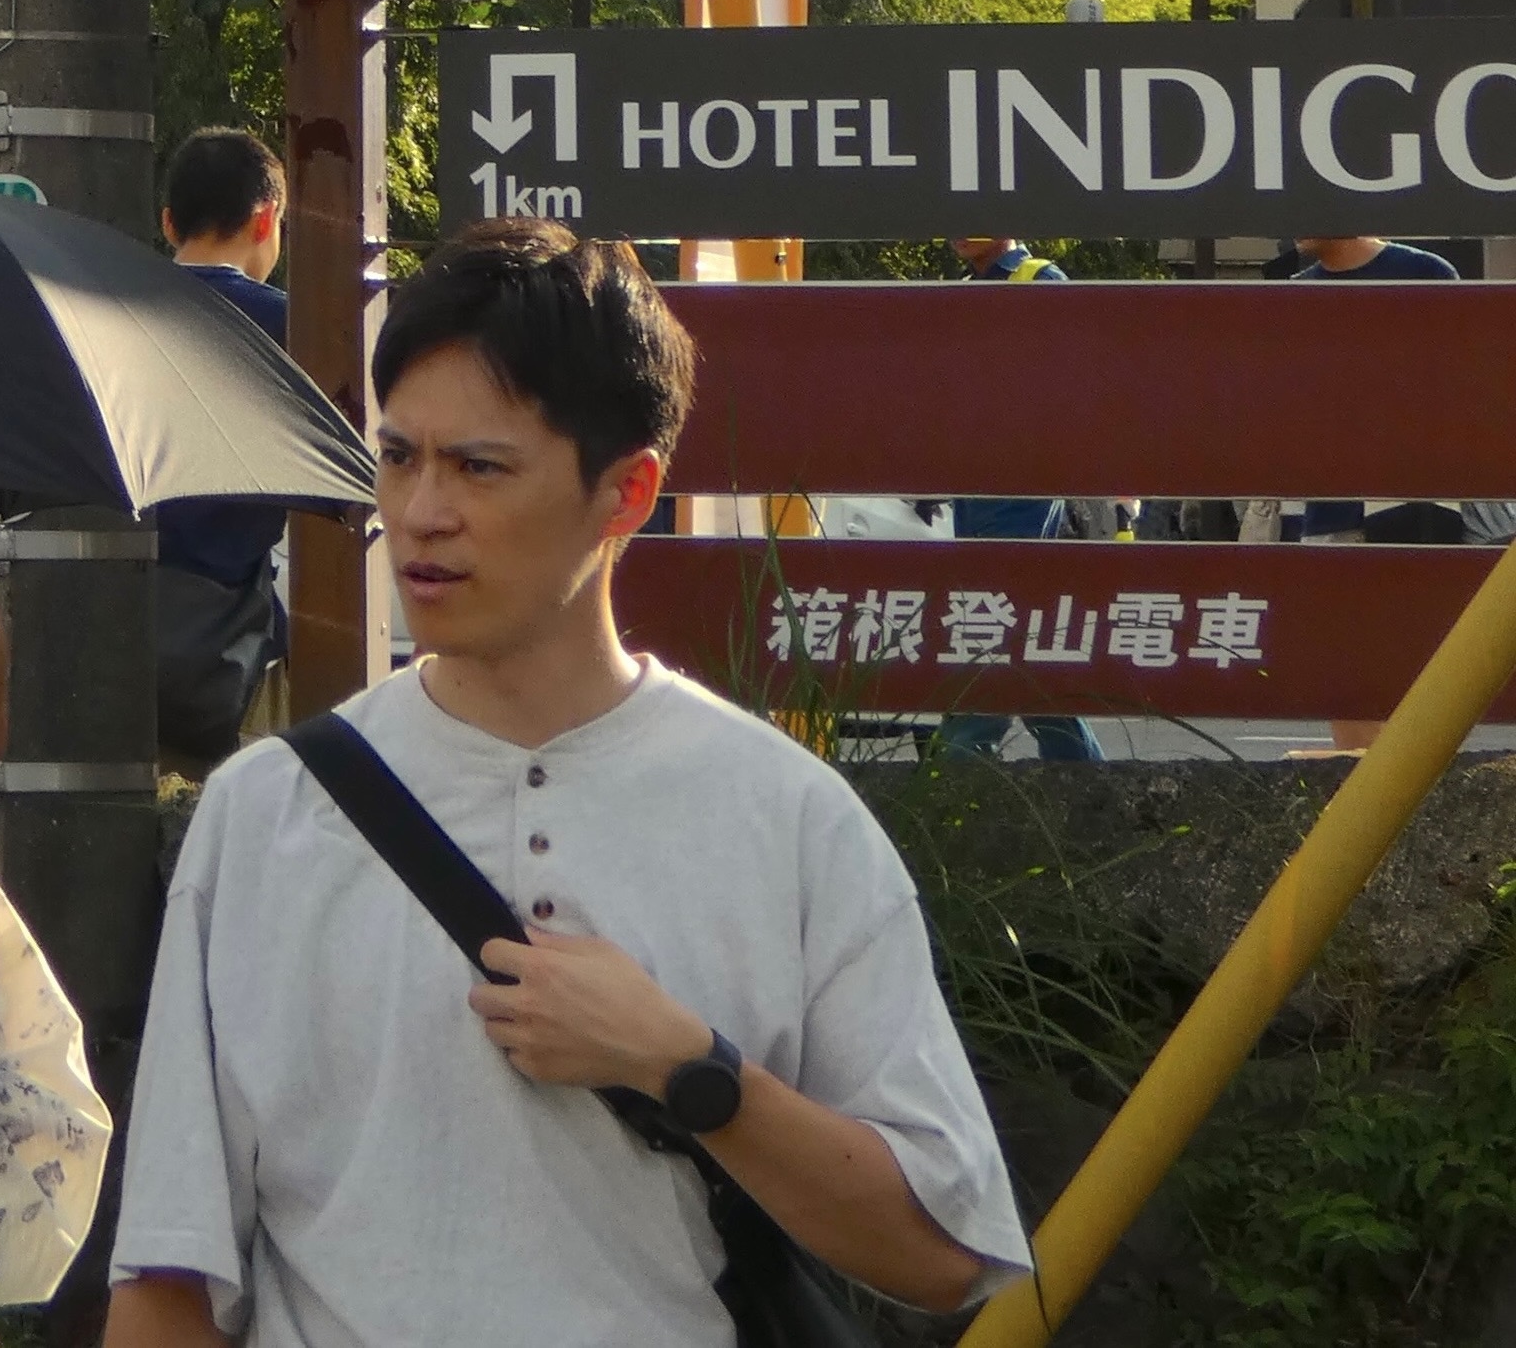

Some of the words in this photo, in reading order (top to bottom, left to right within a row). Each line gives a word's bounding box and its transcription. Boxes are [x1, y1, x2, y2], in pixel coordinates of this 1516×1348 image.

[622, 98, 917, 169] HOTEL
[949, 63, 1516, 193] INDIGO
[470, 162, 582, 221] 1km
[766, 587, 1269, 671] 箱根登山電車
